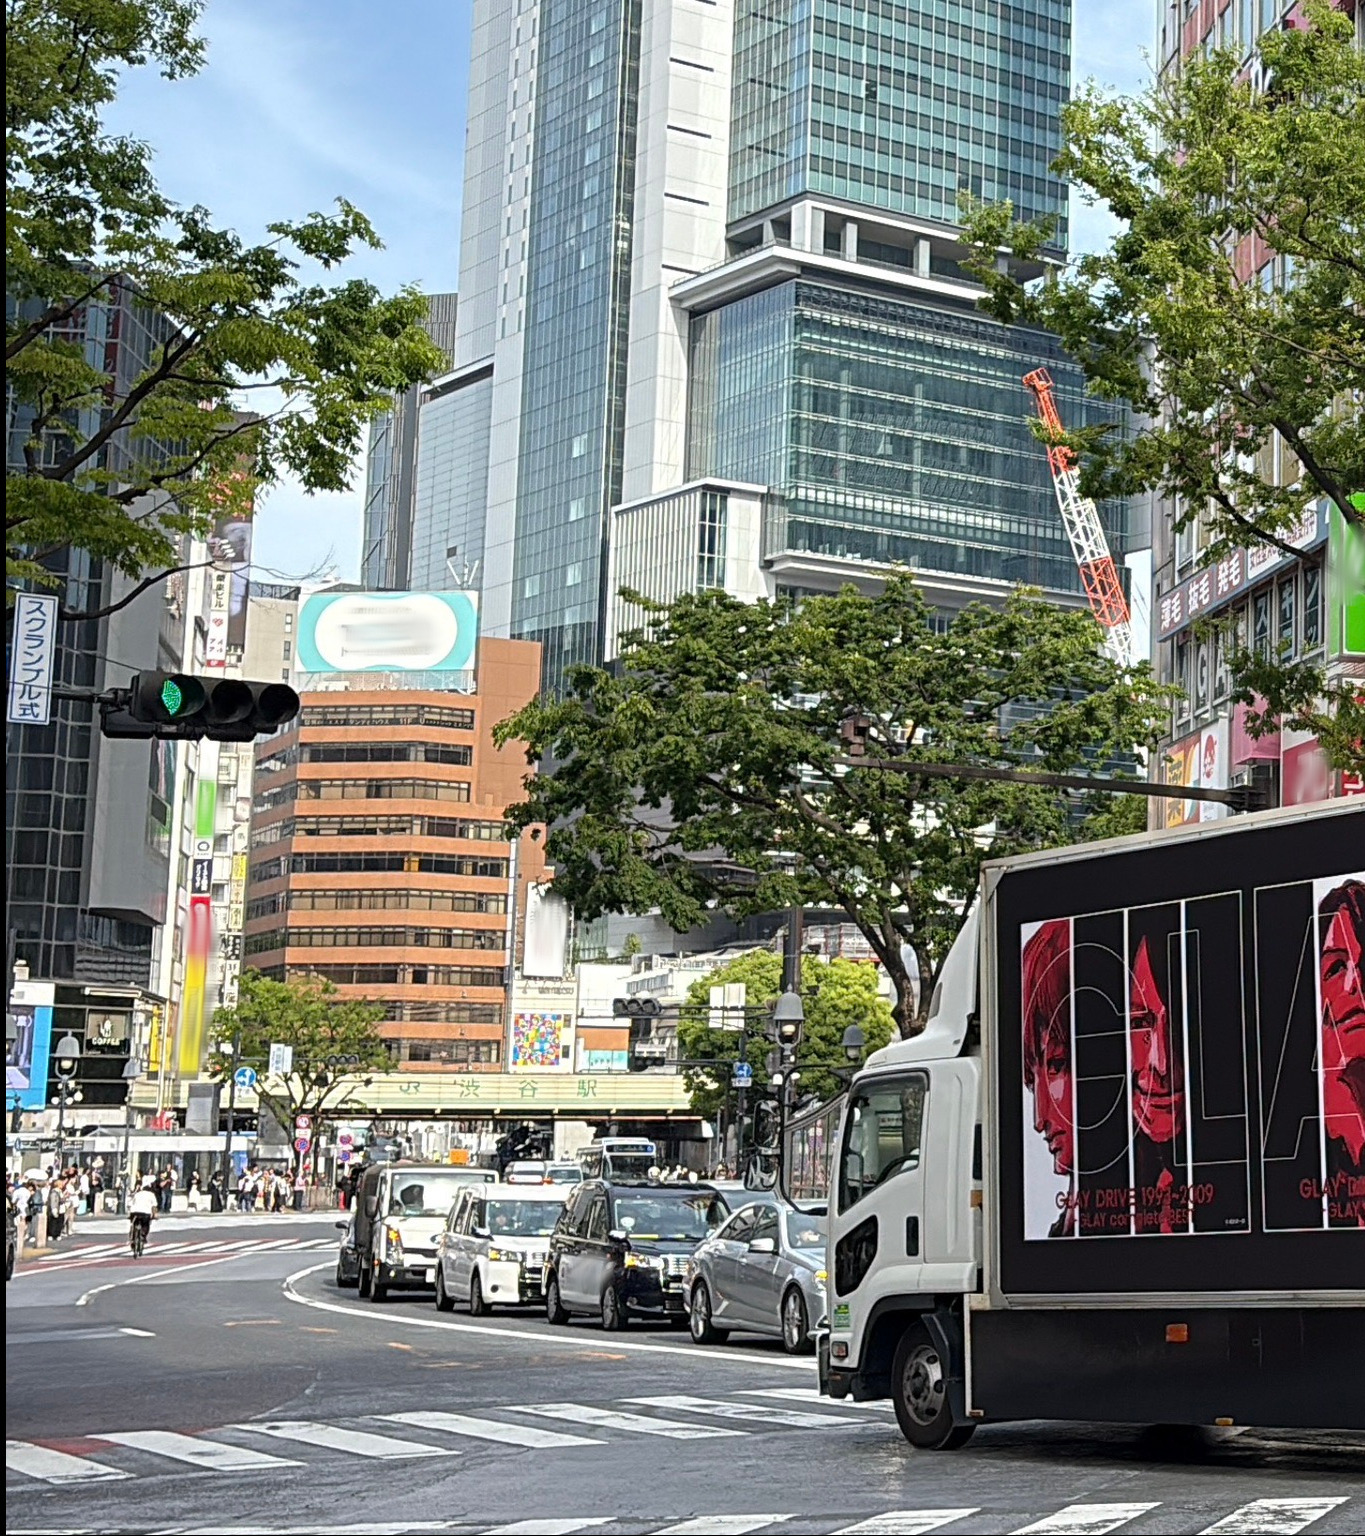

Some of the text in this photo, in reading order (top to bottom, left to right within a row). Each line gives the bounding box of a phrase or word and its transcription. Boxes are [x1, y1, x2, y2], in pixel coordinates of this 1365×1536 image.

[18, 600, 46, 719] スクランブル式
[399, 1078, 597, 1098] JR 渋谷駅
[1056, 1190, 1091, 1209] GLAY
[1096, 1187, 1135, 1208] DRIVE
[1300, 1180, 1339, 1199] GLAY
